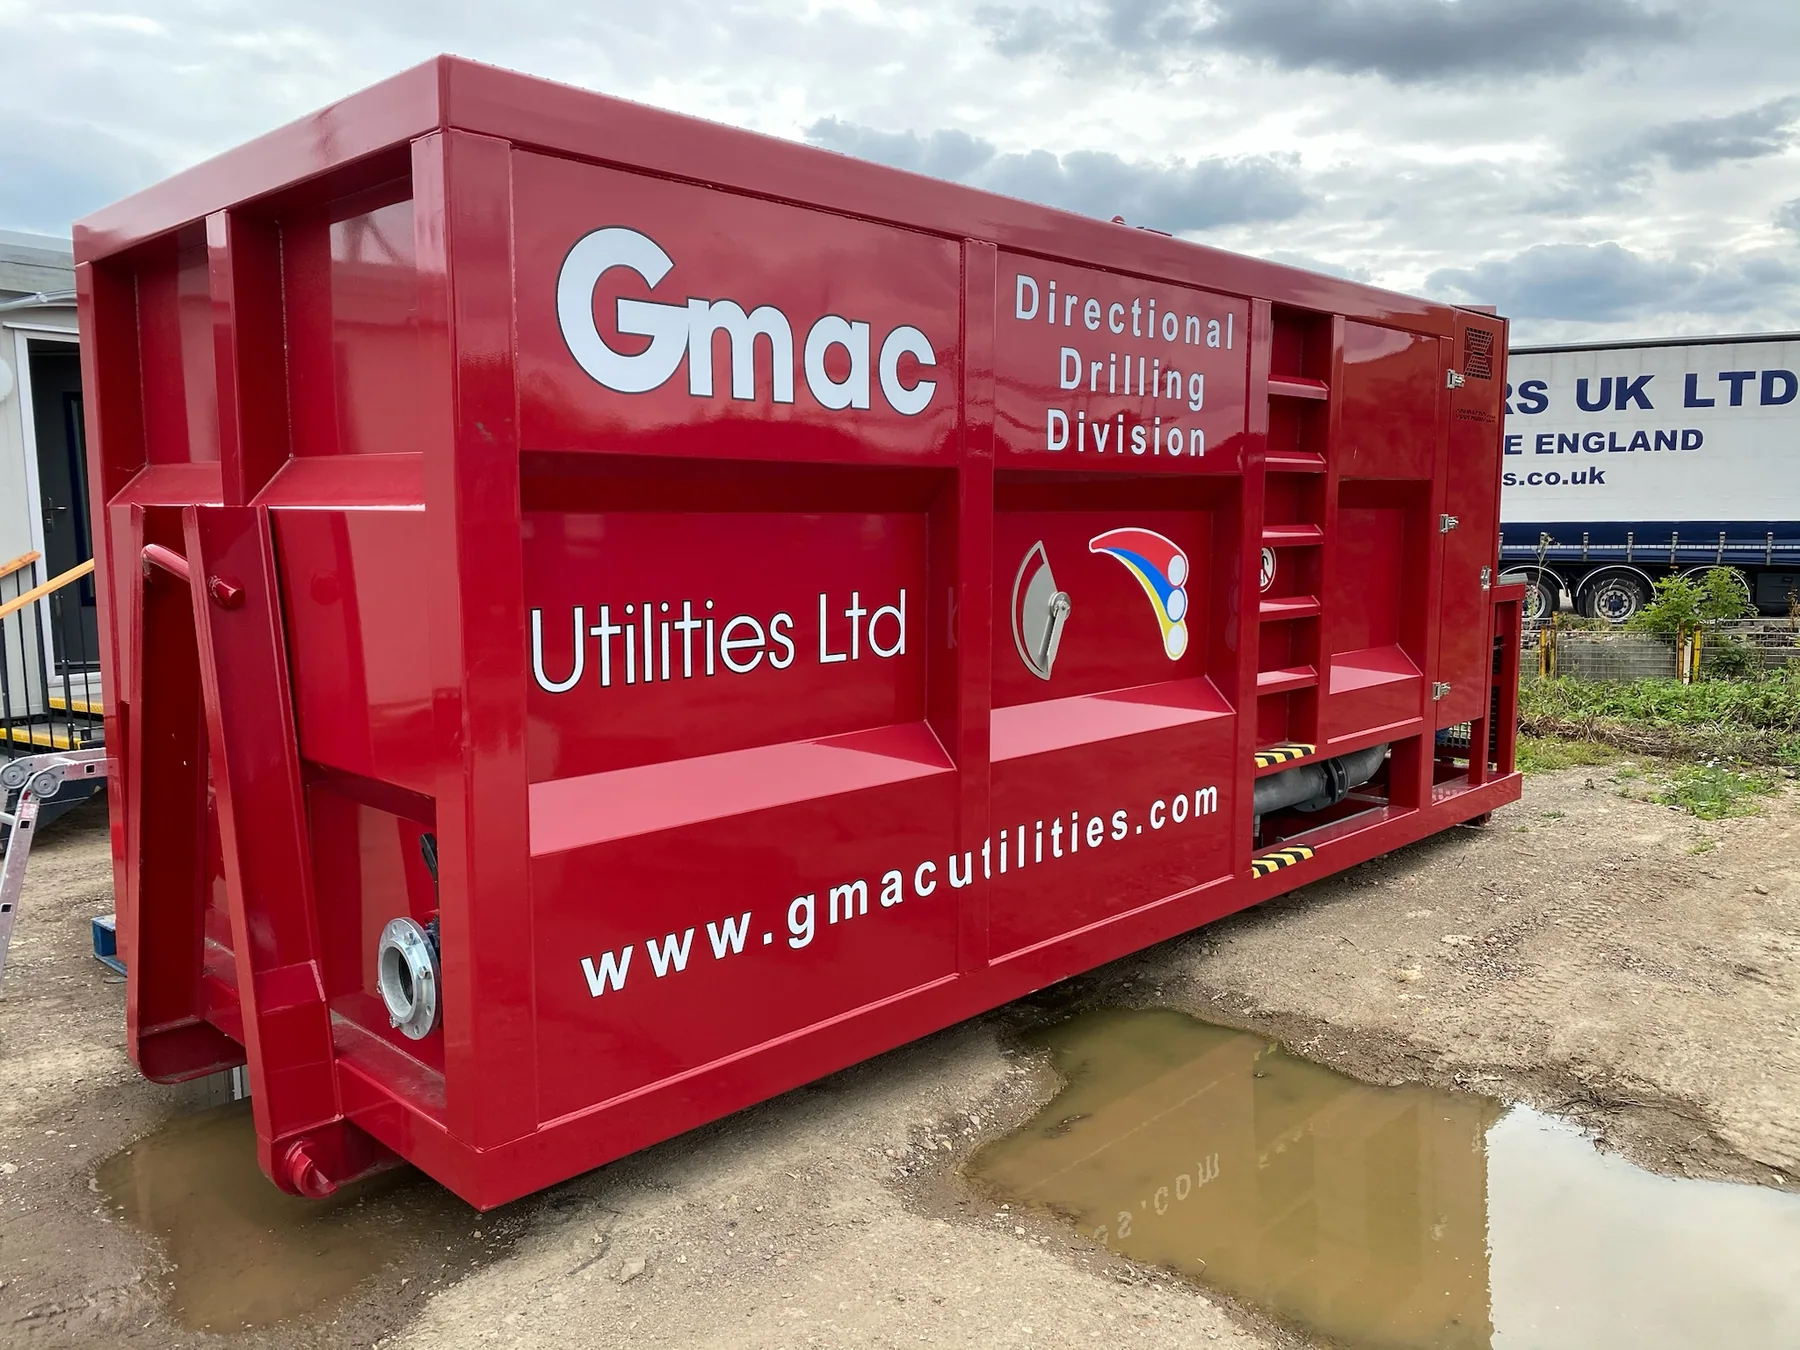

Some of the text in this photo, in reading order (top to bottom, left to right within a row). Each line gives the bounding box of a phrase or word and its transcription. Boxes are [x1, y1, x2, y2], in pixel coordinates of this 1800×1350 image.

[556, 225, 937, 416] Gmac
[1015, 273, 1234, 350] Directional
[1060, 346, 1204, 412] Drilling
[1505, 369, 1799, 414] S UK LTD
[1047, 408, 1205, 457] Division
[1535, 429, 1704, 455] ENGLAND
[1502, 466, 1606, 486] s.co.uk
[530, 588, 907, 694] Utilities Ltd
[579, 784, 1219, 999] www.gmacutilities.com
